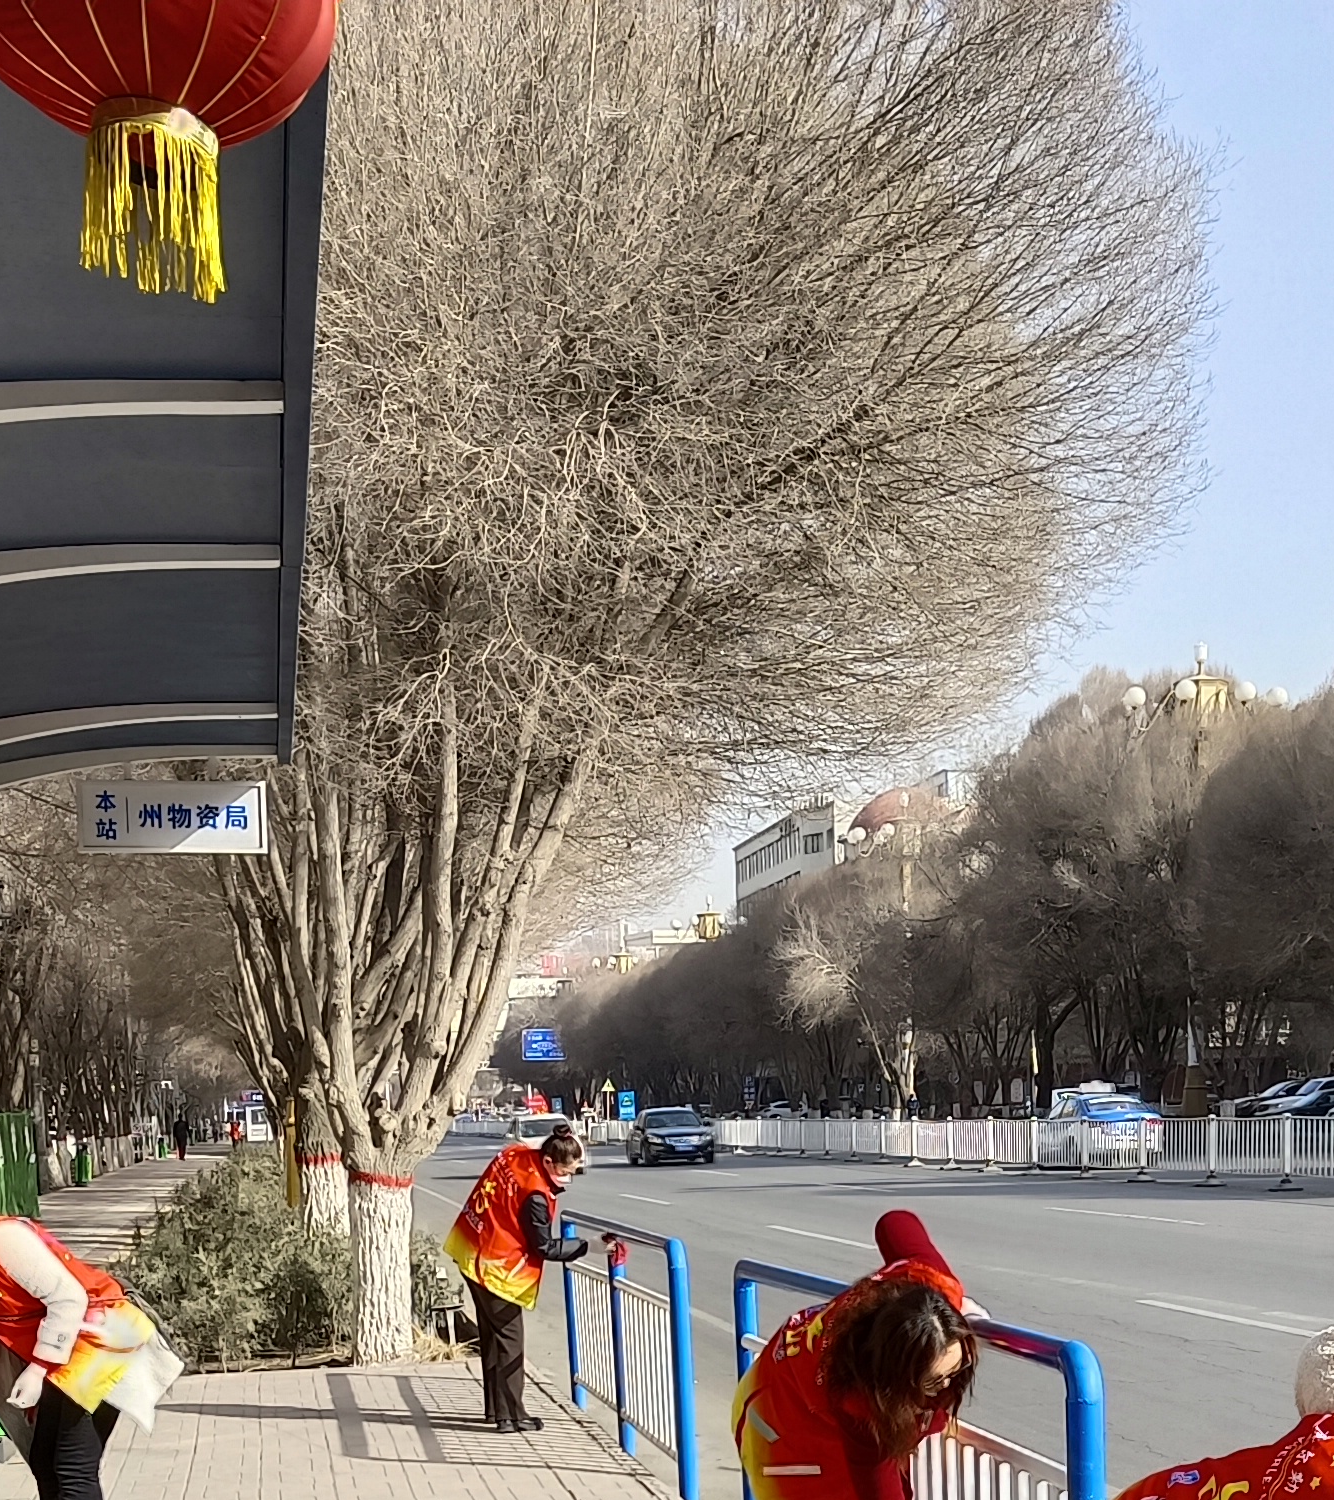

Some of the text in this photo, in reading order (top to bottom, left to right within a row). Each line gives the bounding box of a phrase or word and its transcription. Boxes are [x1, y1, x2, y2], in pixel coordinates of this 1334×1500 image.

[95, 789, 118, 841] 本站
[138, 802, 249, 831] 州物资局
